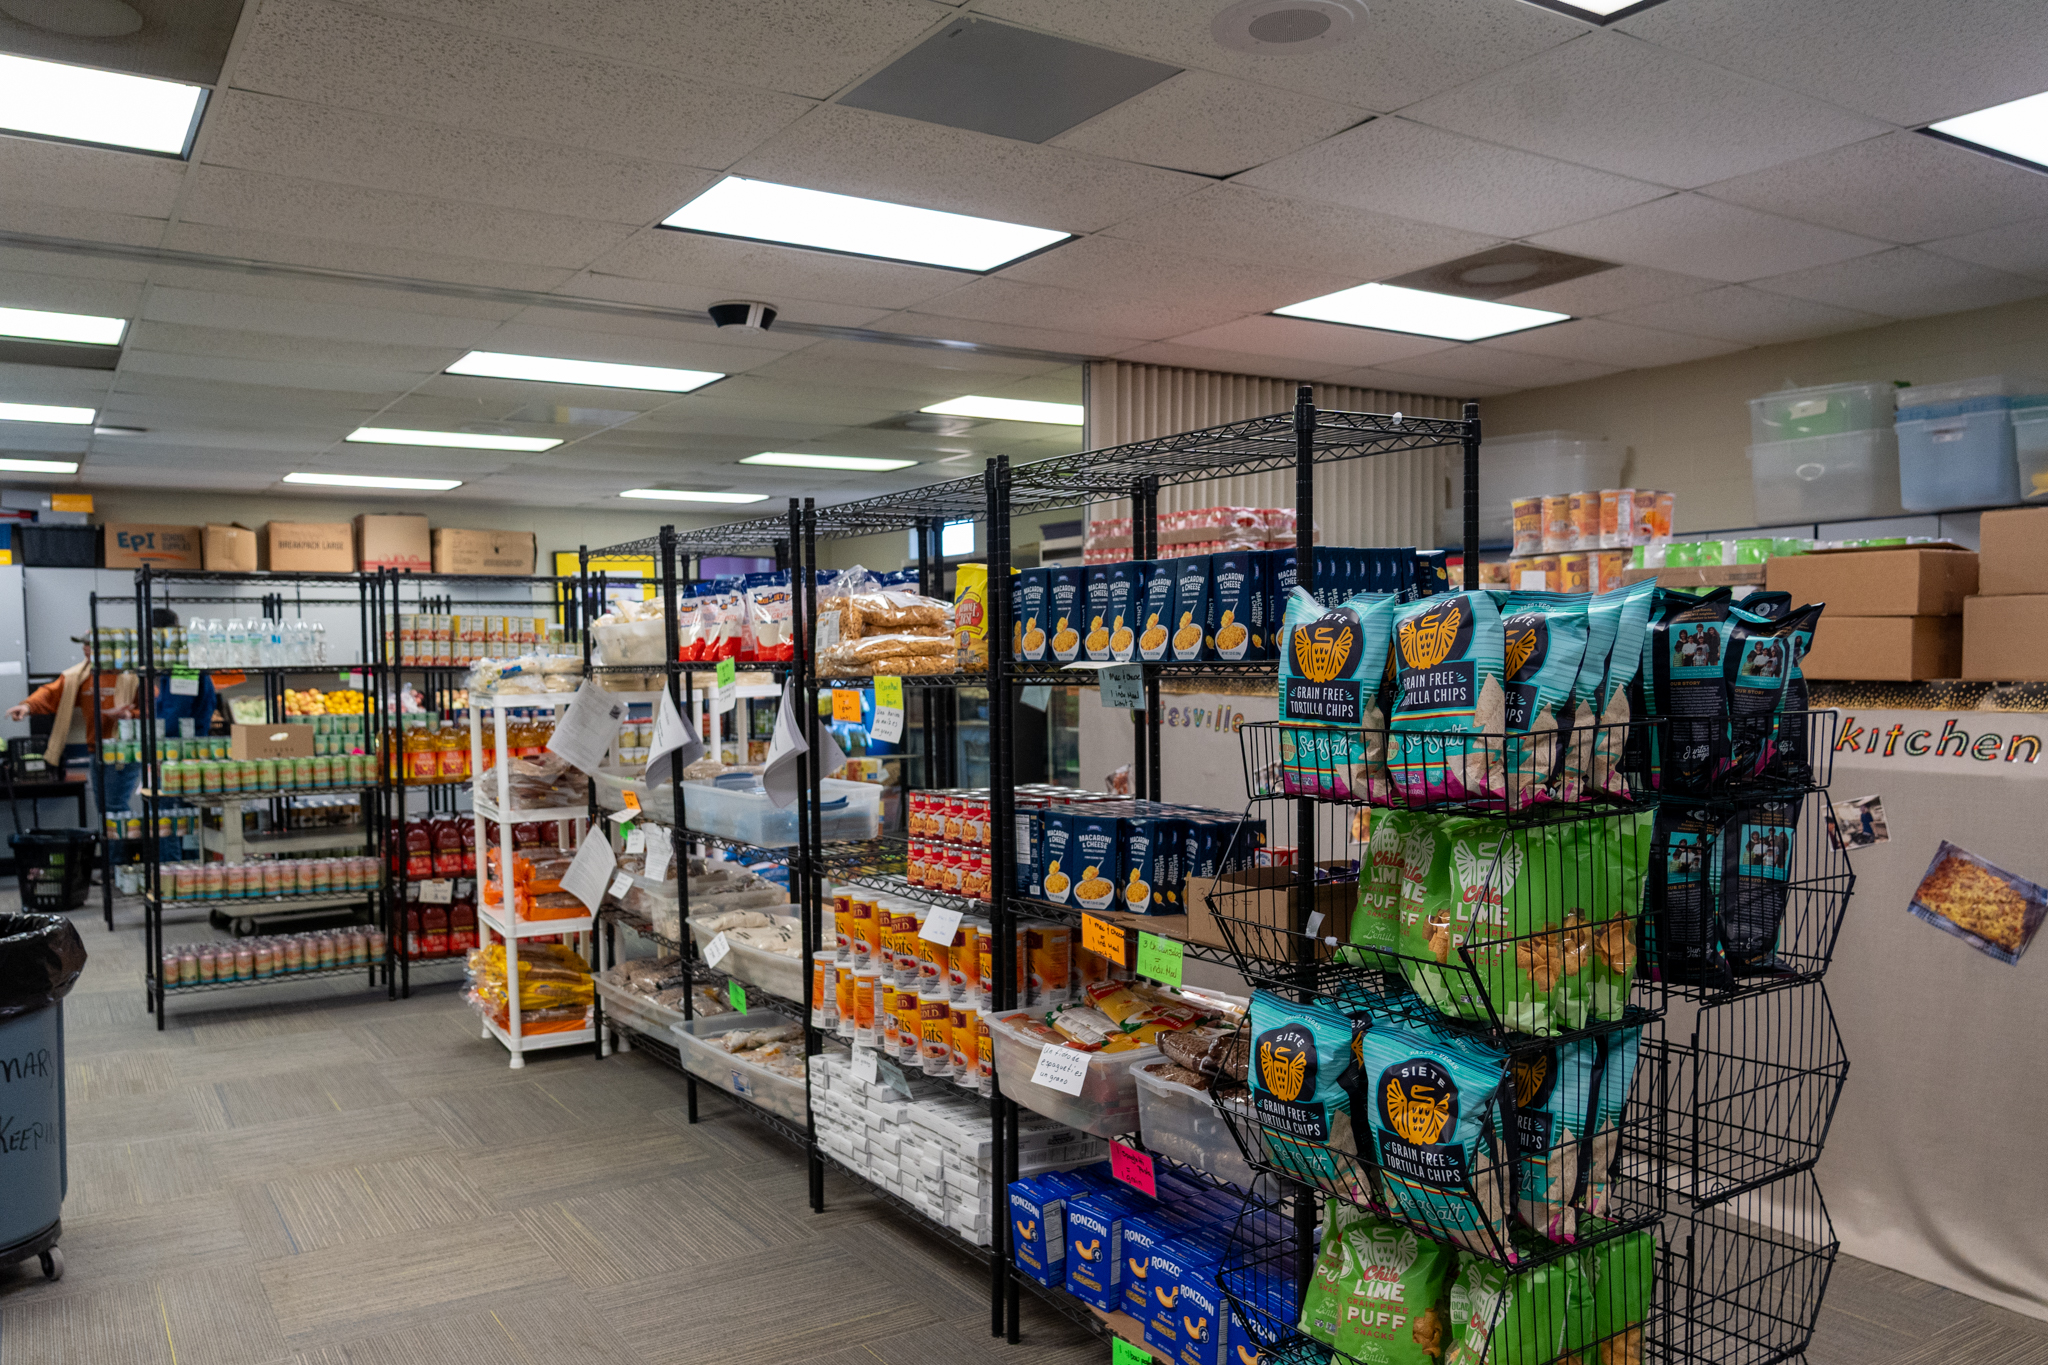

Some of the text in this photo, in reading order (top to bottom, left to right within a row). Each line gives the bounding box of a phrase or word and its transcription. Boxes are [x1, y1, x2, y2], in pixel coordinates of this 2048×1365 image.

[1217, 573, 1244, 583] MACARONI
[1278, 569, 1297, 580] MACAR
[1284, 577, 1297, 585] CHEE
[1224, 581, 1241, 589] CHEESE
[1429, 671, 1455, 686] FREE
[1297, 686, 1344, 701] GRAIN FREE
[1434, 687, 1467, 703] CHIPS
[1505, 692, 1517, 705] EE
[1290, 701, 1354, 718] TORTILLA CHIPS
[1507, 709, 1524, 723] IPS
[1835, 717, 2042, 764] kitchen
[1079, 833, 1112, 844] MACARONI
[1086, 840, 1108, 850] CHEESE
[1373, 851, 1405, 867] Chile
[1401, 880, 1428, 905] ME
[1463, 885, 1502, 906] Chile
[1363, 893, 1398, 911] PUF
[1367, 910, 1401, 920] SNACKS
[1456, 902, 1509, 928] LIME
[1143, 939, 1148, 948] 3
[1363, 930, 1395, 941] Lentils
[1276, 1032, 1305, 1048] SIETE
[1043, 1046, 1053, 1054] Un
[1401, 1066, 1446, 1089] SIETE
[1263, 1099, 1308, 1122] GRAIN FREE
[1258, 1110, 1321, 1137] TORTILLA CHIPS
[1518, 1115, 1532, 1130] REE
[1391, 1141, 1446, 1168] GRAIN FREE
[1386, 1153, 1461, 1183] TORTILLA CHIPS
[1011, 1194, 1040, 1219] RONZONI
[1070, 1213, 1107, 1237] RONZONI
[1124, 1229, 1154, 1248] RONZO
[1151, 1256, 1183, 1277] RONZO
[1363, 1265, 1401, 1284] Chile
[1319, 1283, 1340, 1296] SNAC
[1352, 1279, 1406, 1305] LIME
[1180, 1284, 1214, 1316] RONZONI
[1347, 1297, 1409, 1315] GRAIN FREE
[1347, 1306, 1406, 1332] PUFF
[1354, 1327, 1395, 1341] SNACKS
[1353, 1350, 1390, 1364] Lentils
